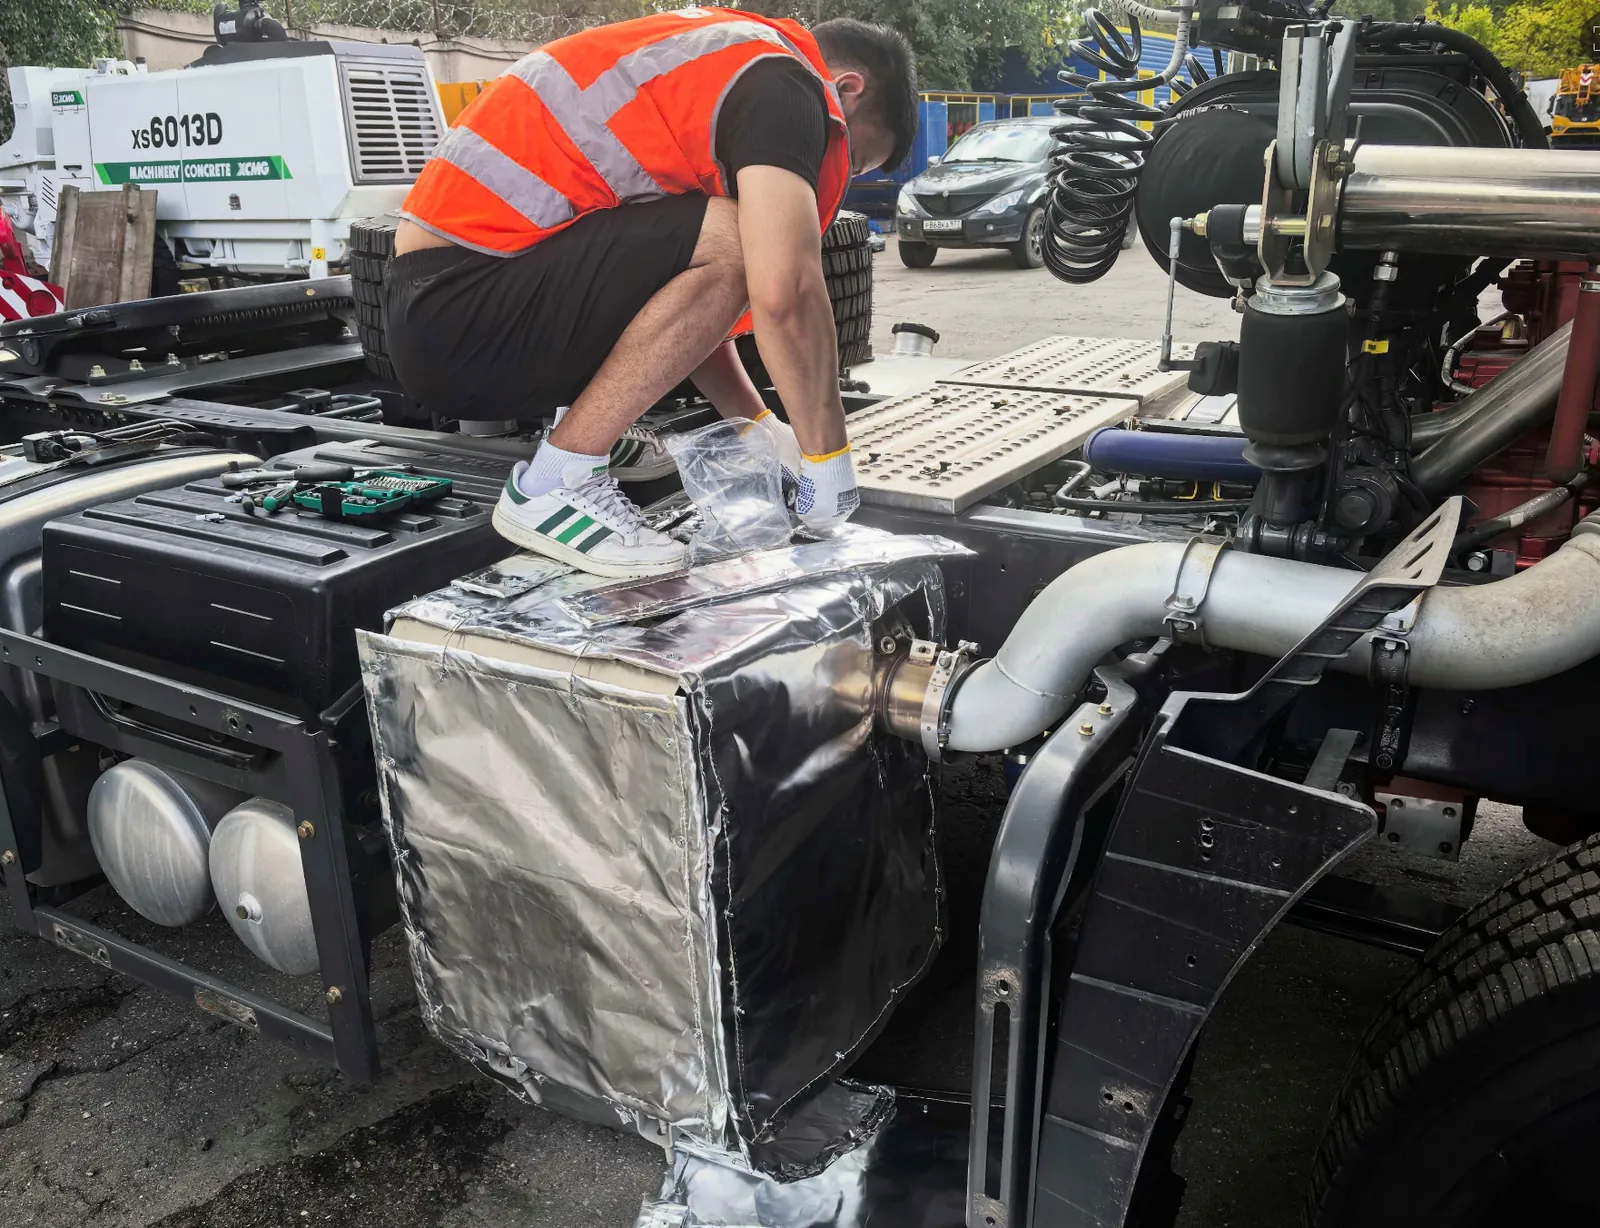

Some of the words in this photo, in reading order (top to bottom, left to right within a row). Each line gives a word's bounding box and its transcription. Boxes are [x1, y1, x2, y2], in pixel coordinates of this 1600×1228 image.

[129, 164, 181, 180] MACHINERY
[184, 162, 232, 179] CONCRETE
[236, 160, 270, 177] XCMG
